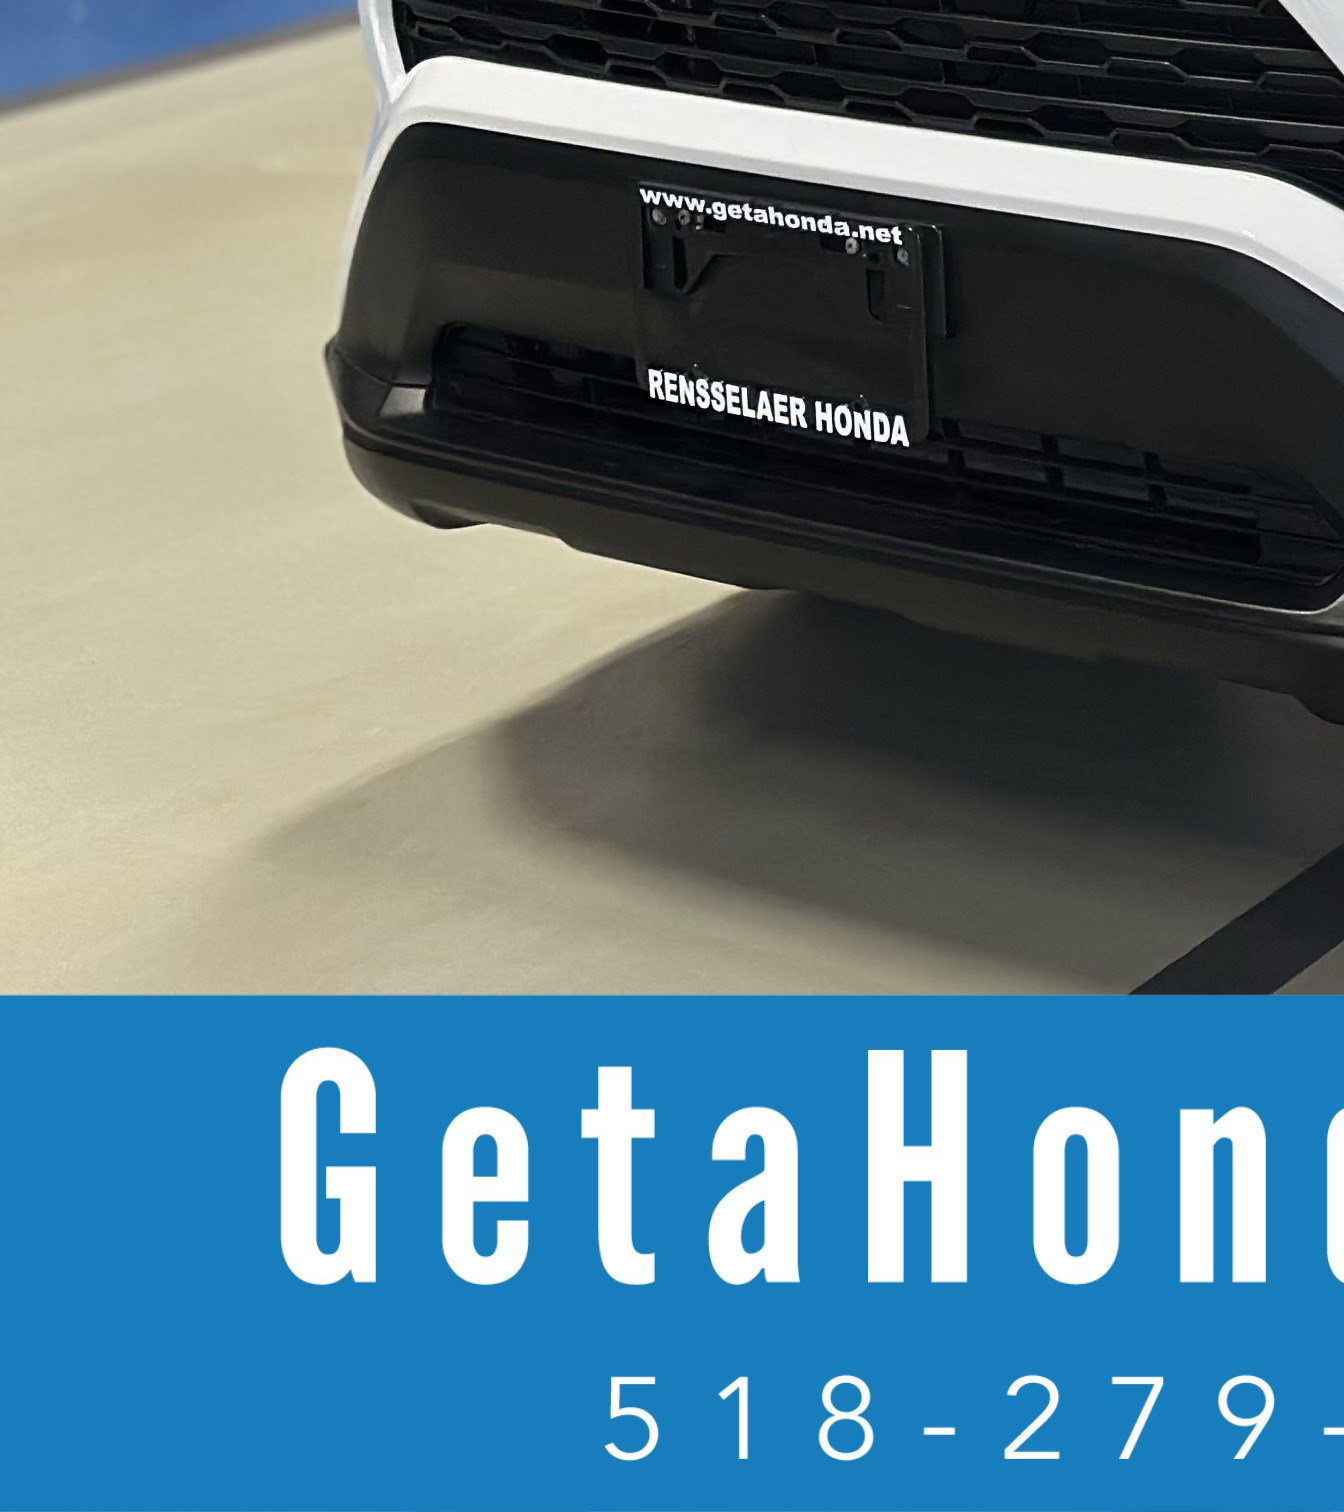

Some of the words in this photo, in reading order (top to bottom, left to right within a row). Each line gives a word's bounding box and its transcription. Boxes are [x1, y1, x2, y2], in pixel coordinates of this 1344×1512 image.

[639, 187, 903, 246] www.getahonda.net
[647, 368, 808, 429] RENSSELAER
[814, 400, 911, 448] HONDA
